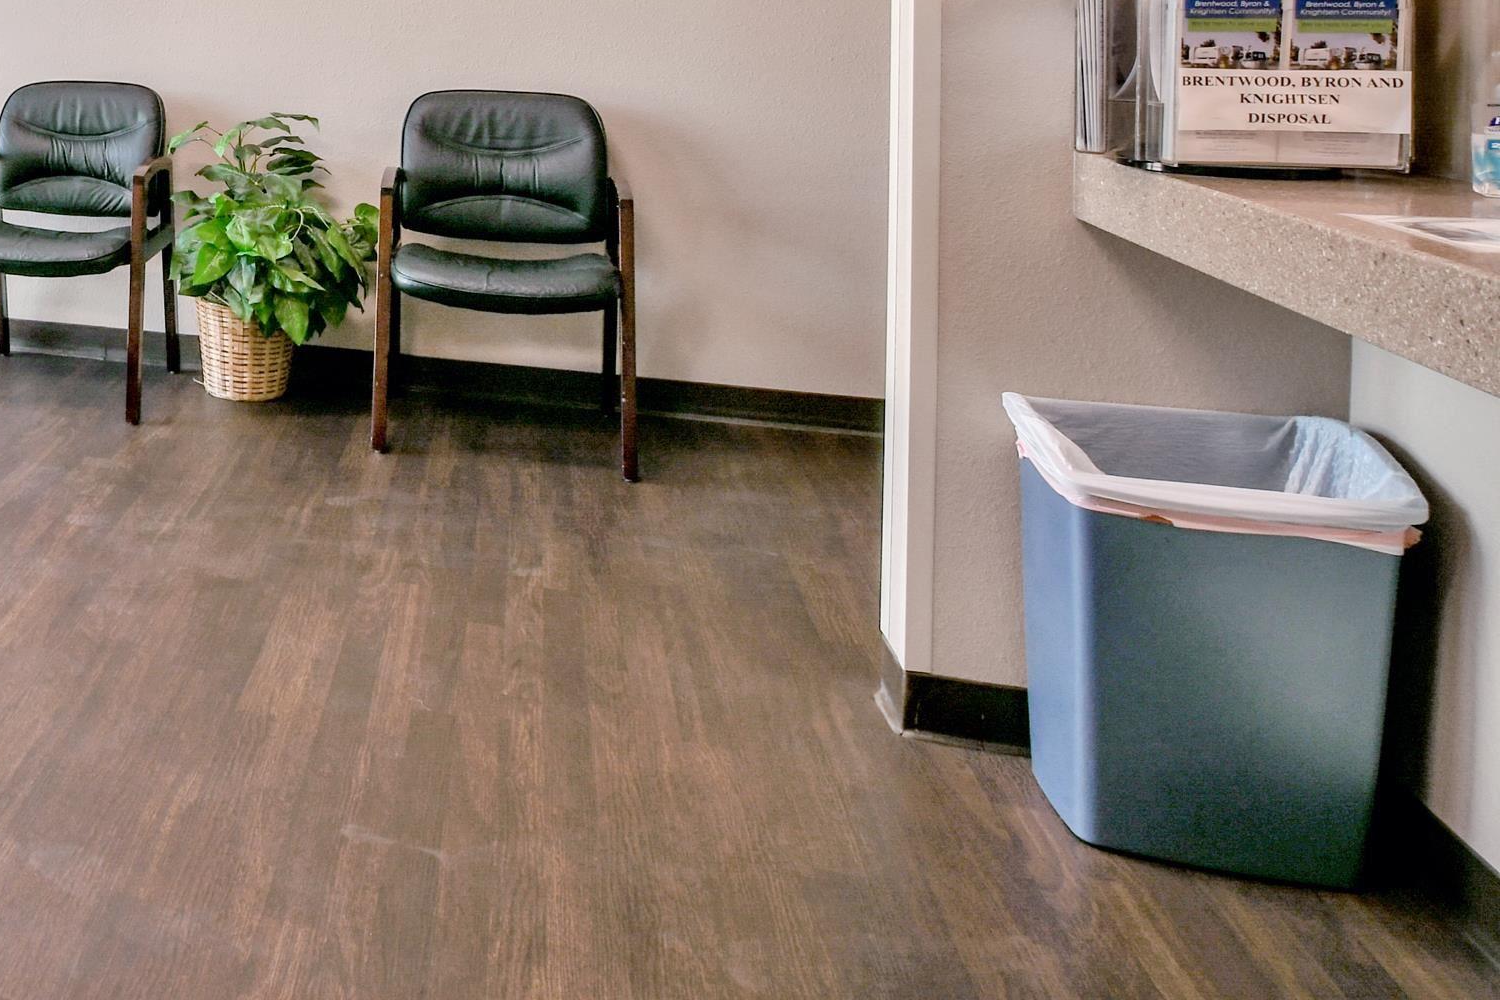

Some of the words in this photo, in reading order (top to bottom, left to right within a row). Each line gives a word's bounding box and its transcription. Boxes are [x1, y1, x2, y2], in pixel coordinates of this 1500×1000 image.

[1240, 0, 1262, 9] Byron
[1264, 0, 1270, 8] &
[1354, 1, 1376, 10] Byron
[1190, 8, 1227, 17] Knightsen
[1228, 8, 1276, 17] Community!
[1300, 8, 1339, 18] Knightsen
[1341, 8, 1391, 18] Community!
[1182, 76, 1296, 89] BRENTWOOD,
[1301, 77, 1362, 88] BYRON
[1366, 77, 1404, 89] AND
[1240, 93, 1340, 105] KNIGHTSEN
[1248, 112, 1332, 125] DISPOSAL
